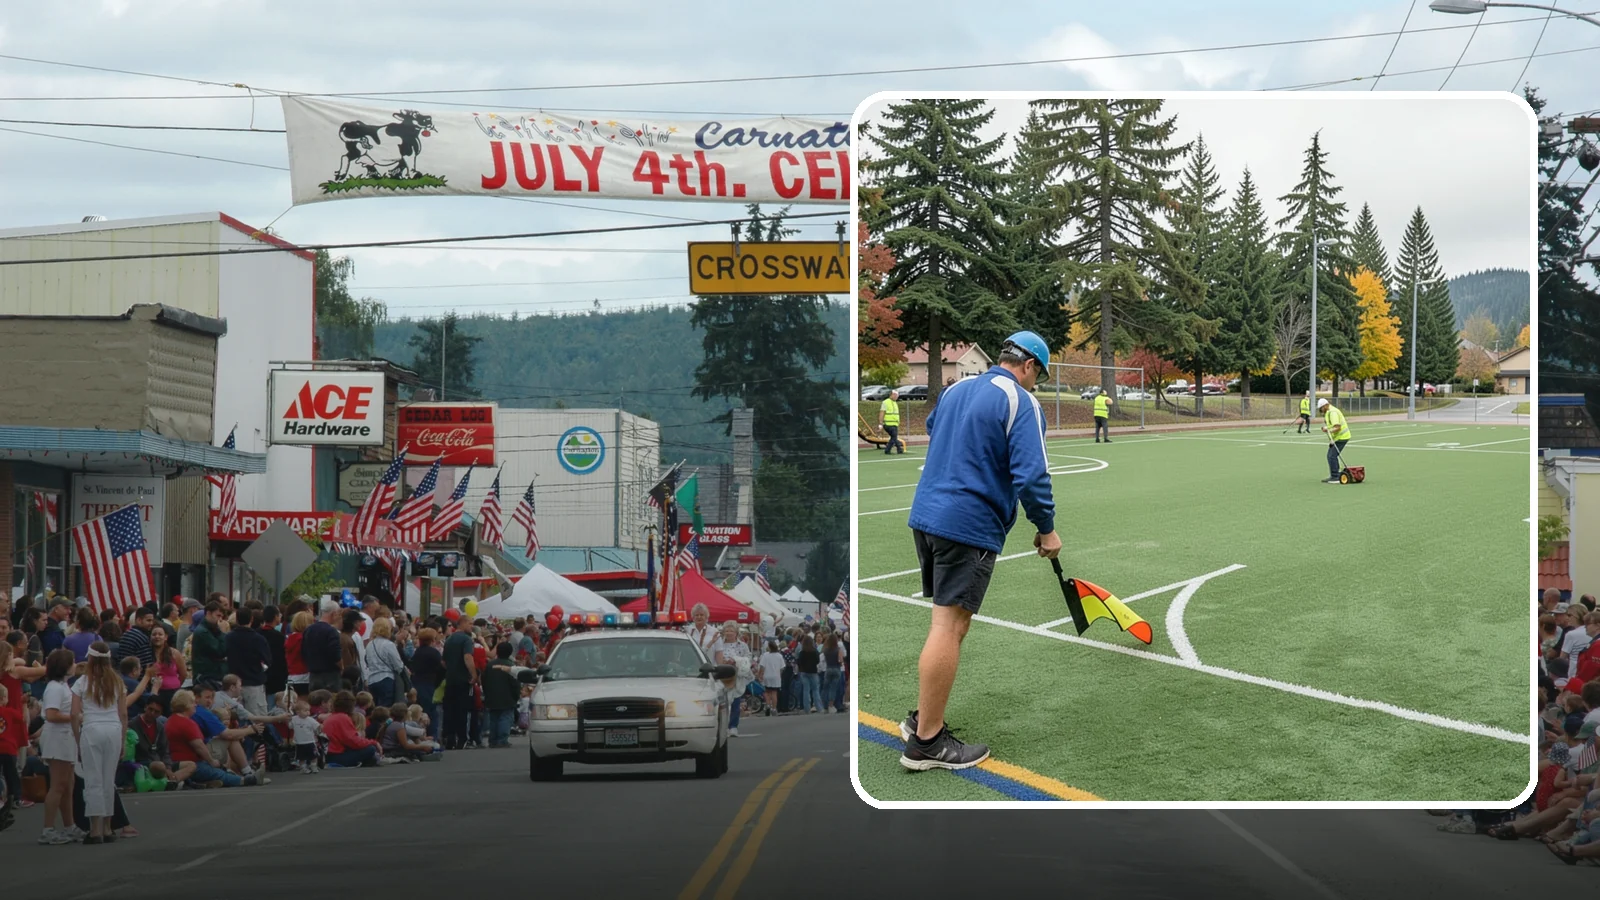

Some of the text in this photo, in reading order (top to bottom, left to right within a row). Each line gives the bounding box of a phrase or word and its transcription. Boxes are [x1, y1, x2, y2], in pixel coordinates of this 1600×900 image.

[481, 141, 605, 192] JULY
[632, 150, 746, 197] 4th.
[697, 254, 850, 279] CROSSWA
[283, 380, 373, 419] ACE
[406, 410, 485, 422] CEDAR LOG
[283, 421, 370, 436] Hardware
[416, 428, 476, 446] Coca-Cola
[83, 485, 155, 495] St. Vincent de Paul
[688, 526, 741, 535] CRNATION
[699, 535, 730, 543] GLASS
